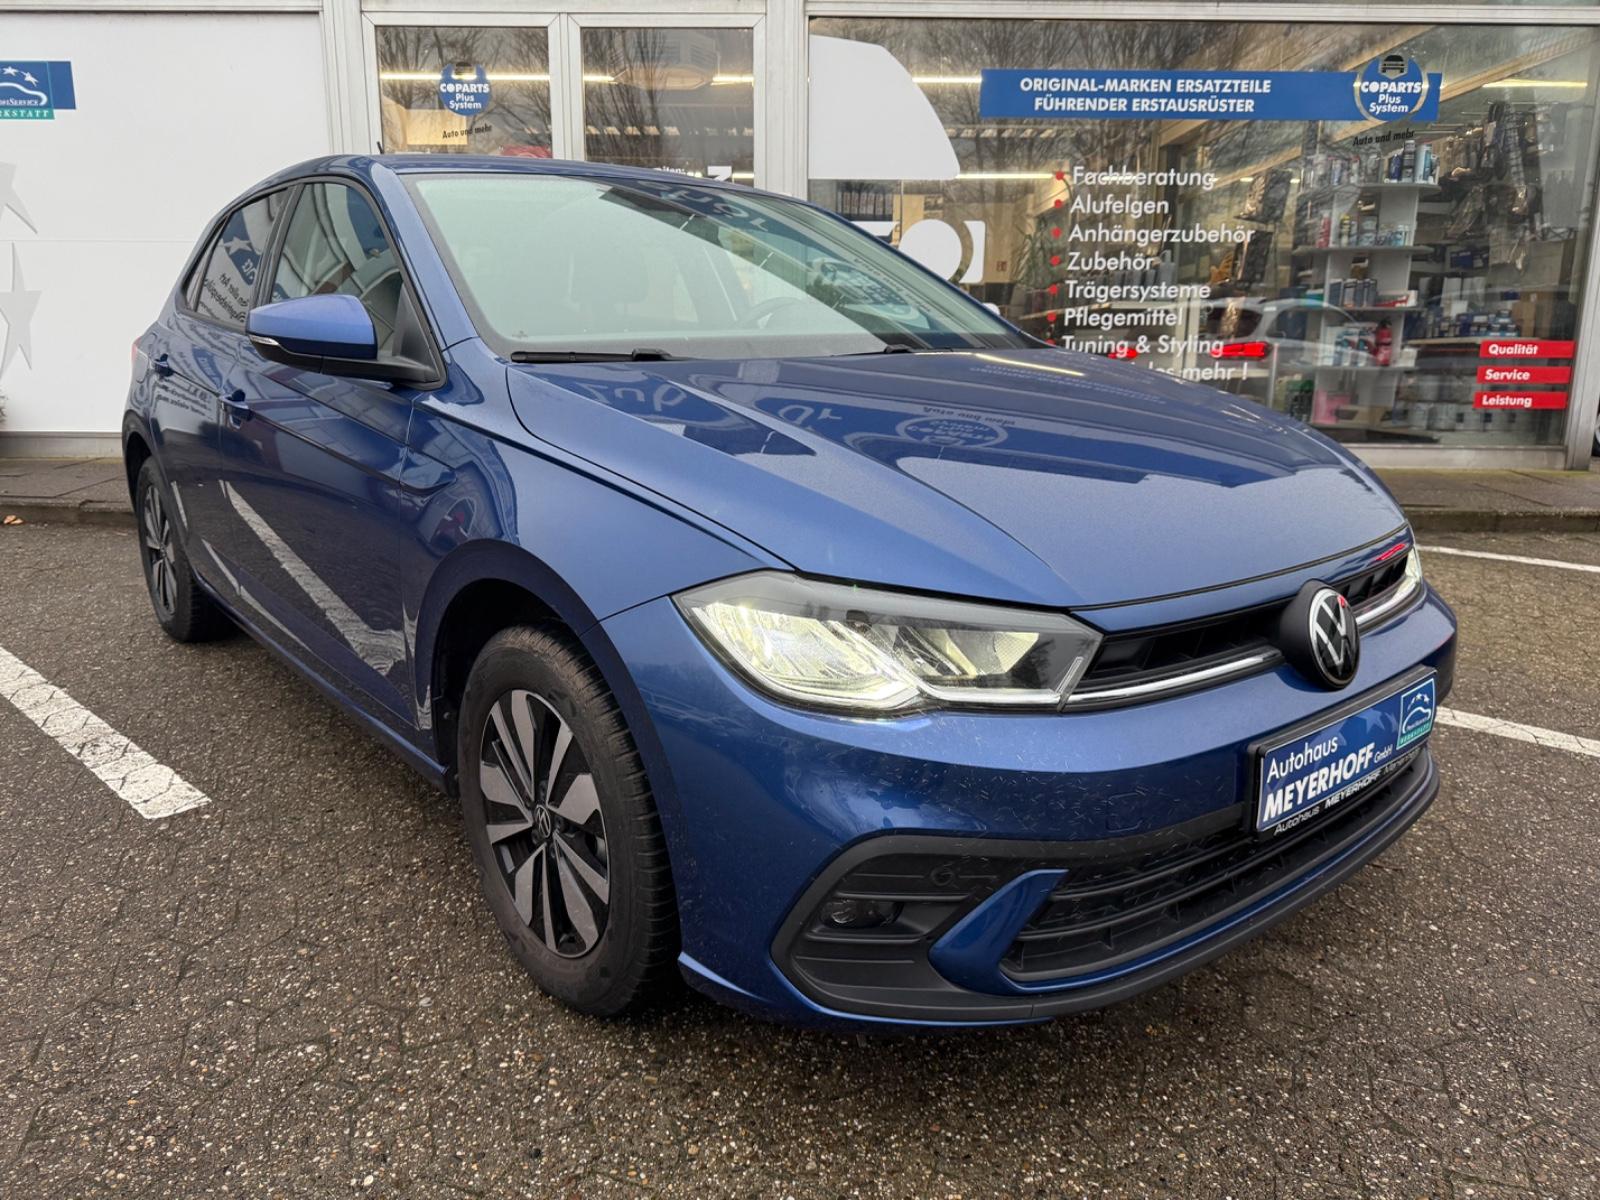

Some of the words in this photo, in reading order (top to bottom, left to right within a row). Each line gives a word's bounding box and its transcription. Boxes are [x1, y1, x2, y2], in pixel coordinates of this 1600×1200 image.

[440, 83, 490, 93] COPARTS
[1020, 78, 1171, 93] ORIGINAL-MARKEN
[1176, 79, 1272, 93] ERSATZTEILE
[1360, 81, 1422, 93] COPARTS
[449, 100, 482, 110] System
[455, 93, 475, 102] Plus
[1034, 94, 1127, 111] FÜHRENDER
[1132, 95, 1255, 112] ERSTAUSRÜSTER
[1378, 93, 1402, 104] Plus
[1369, 102, 1409, 115] System
[442, 130, 459, 138] Auto
[460, 127, 473, 136] und
[474, 122, 492, 134] mehr
[1353, 136, 1374, 146] Auto
[1375, 130, 1393, 143] und
[1394, 128, 1415, 140] mehr
[1073, 166, 1215, 190] Fachberatung
[1069, 194, 1169, 219] Alufelgen
[1067, 223, 1255, 247] Anhängerzubehör
[1066, 250, 1153, 271] Zubehör
[1065, 280, 1211, 303] Trägersysteme
[1063, 308, 1183, 330] Pflegemittel
[1062, 335, 1128, 358] Tuning
[1135, 335, 1150, 353] &
[1157, 335, 1224, 358] Styling
[1488, 343, 1538, 355] Qualität
[1182, 361, 1236, 382] mehr
[1485, 369, 1530, 380] Service
[1482, 395, 1533, 408] Leistung
[1266, 737, 1338, 783] Autohaus
[1263, 743, 1375, 822] MEYERHOFF
[1373, 743, 1393, 764] GmbH
[1273, 807, 1320, 836] Autohaus
[1324, 771, 1381, 809] MEYERHOFF
